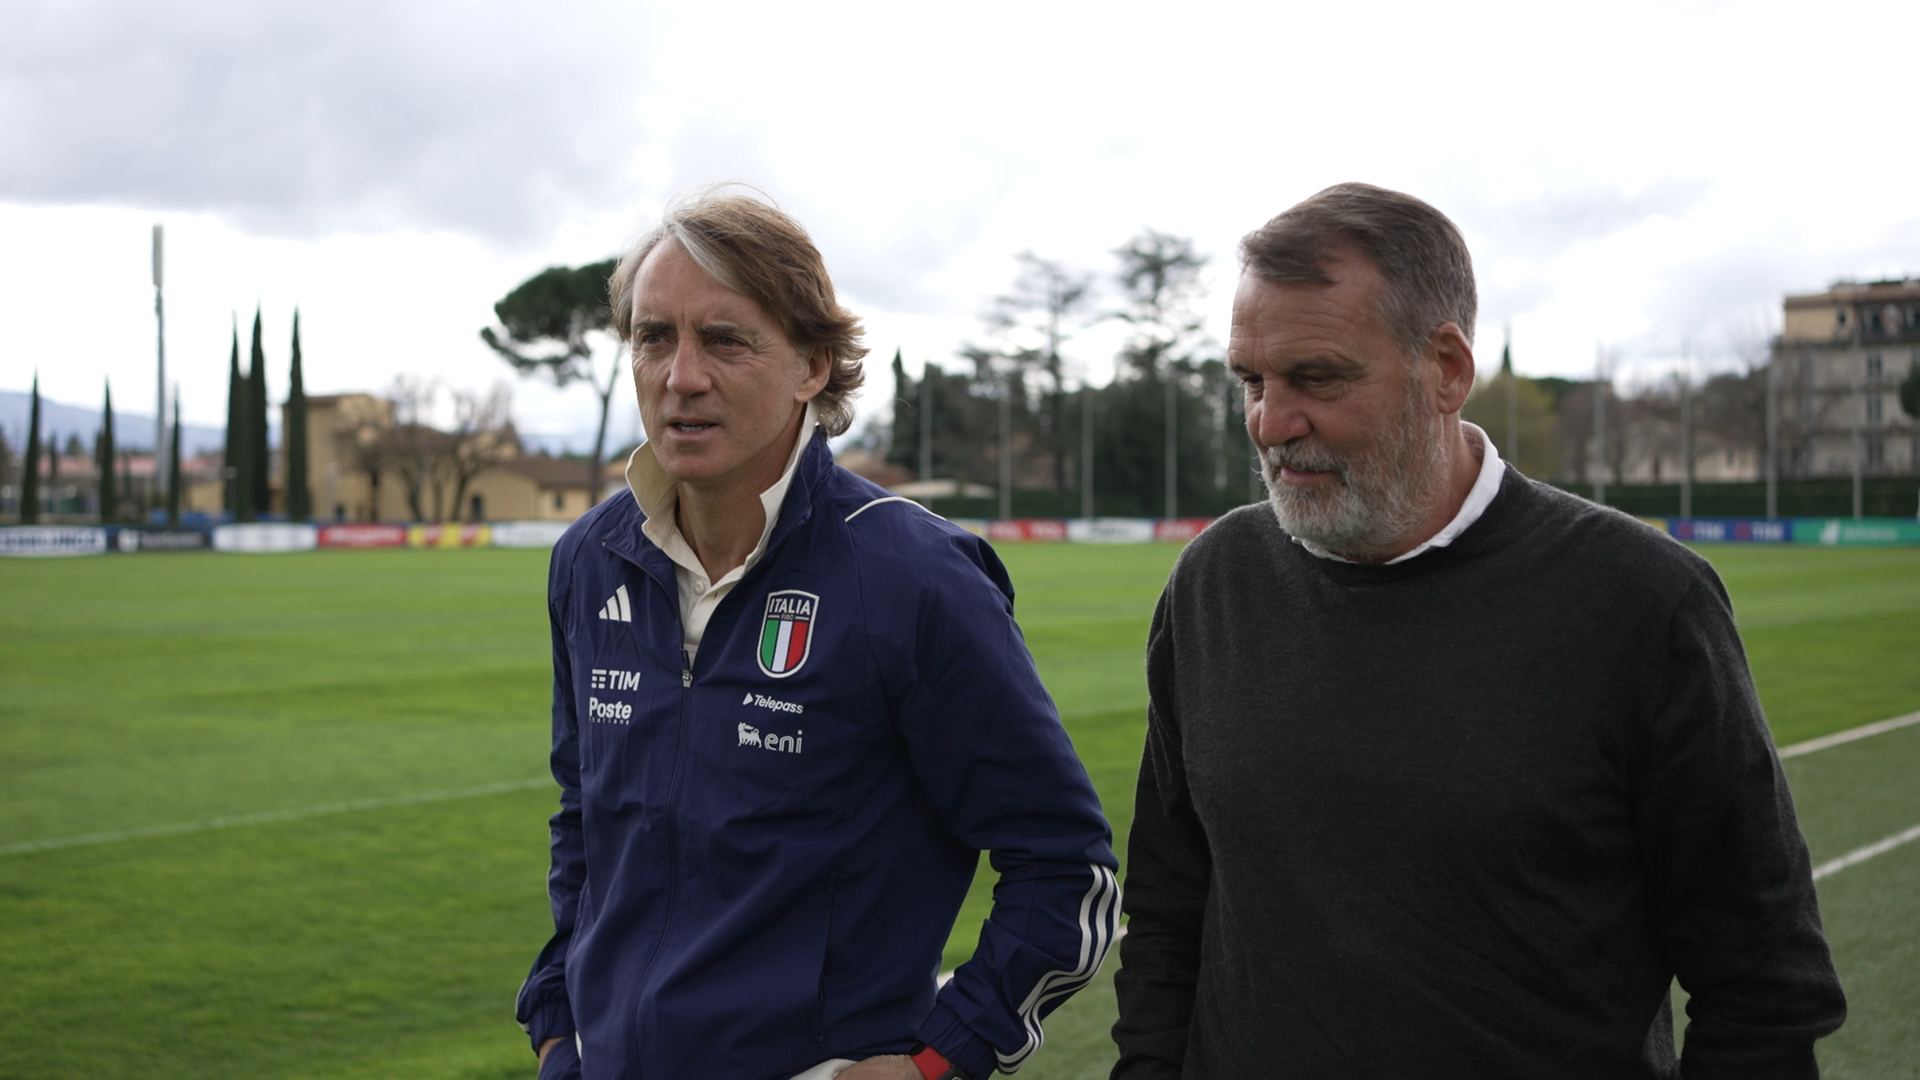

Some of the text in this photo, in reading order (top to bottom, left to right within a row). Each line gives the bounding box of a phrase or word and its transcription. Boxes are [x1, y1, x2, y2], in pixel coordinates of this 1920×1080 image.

[769, 598, 811, 616] ITALIA
[609, 670, 641, 691] TIM
[589, 697, 632, 720] Poste
[754, 694, 804, 714] Telepass
[764, 729, 803, 754] eni
